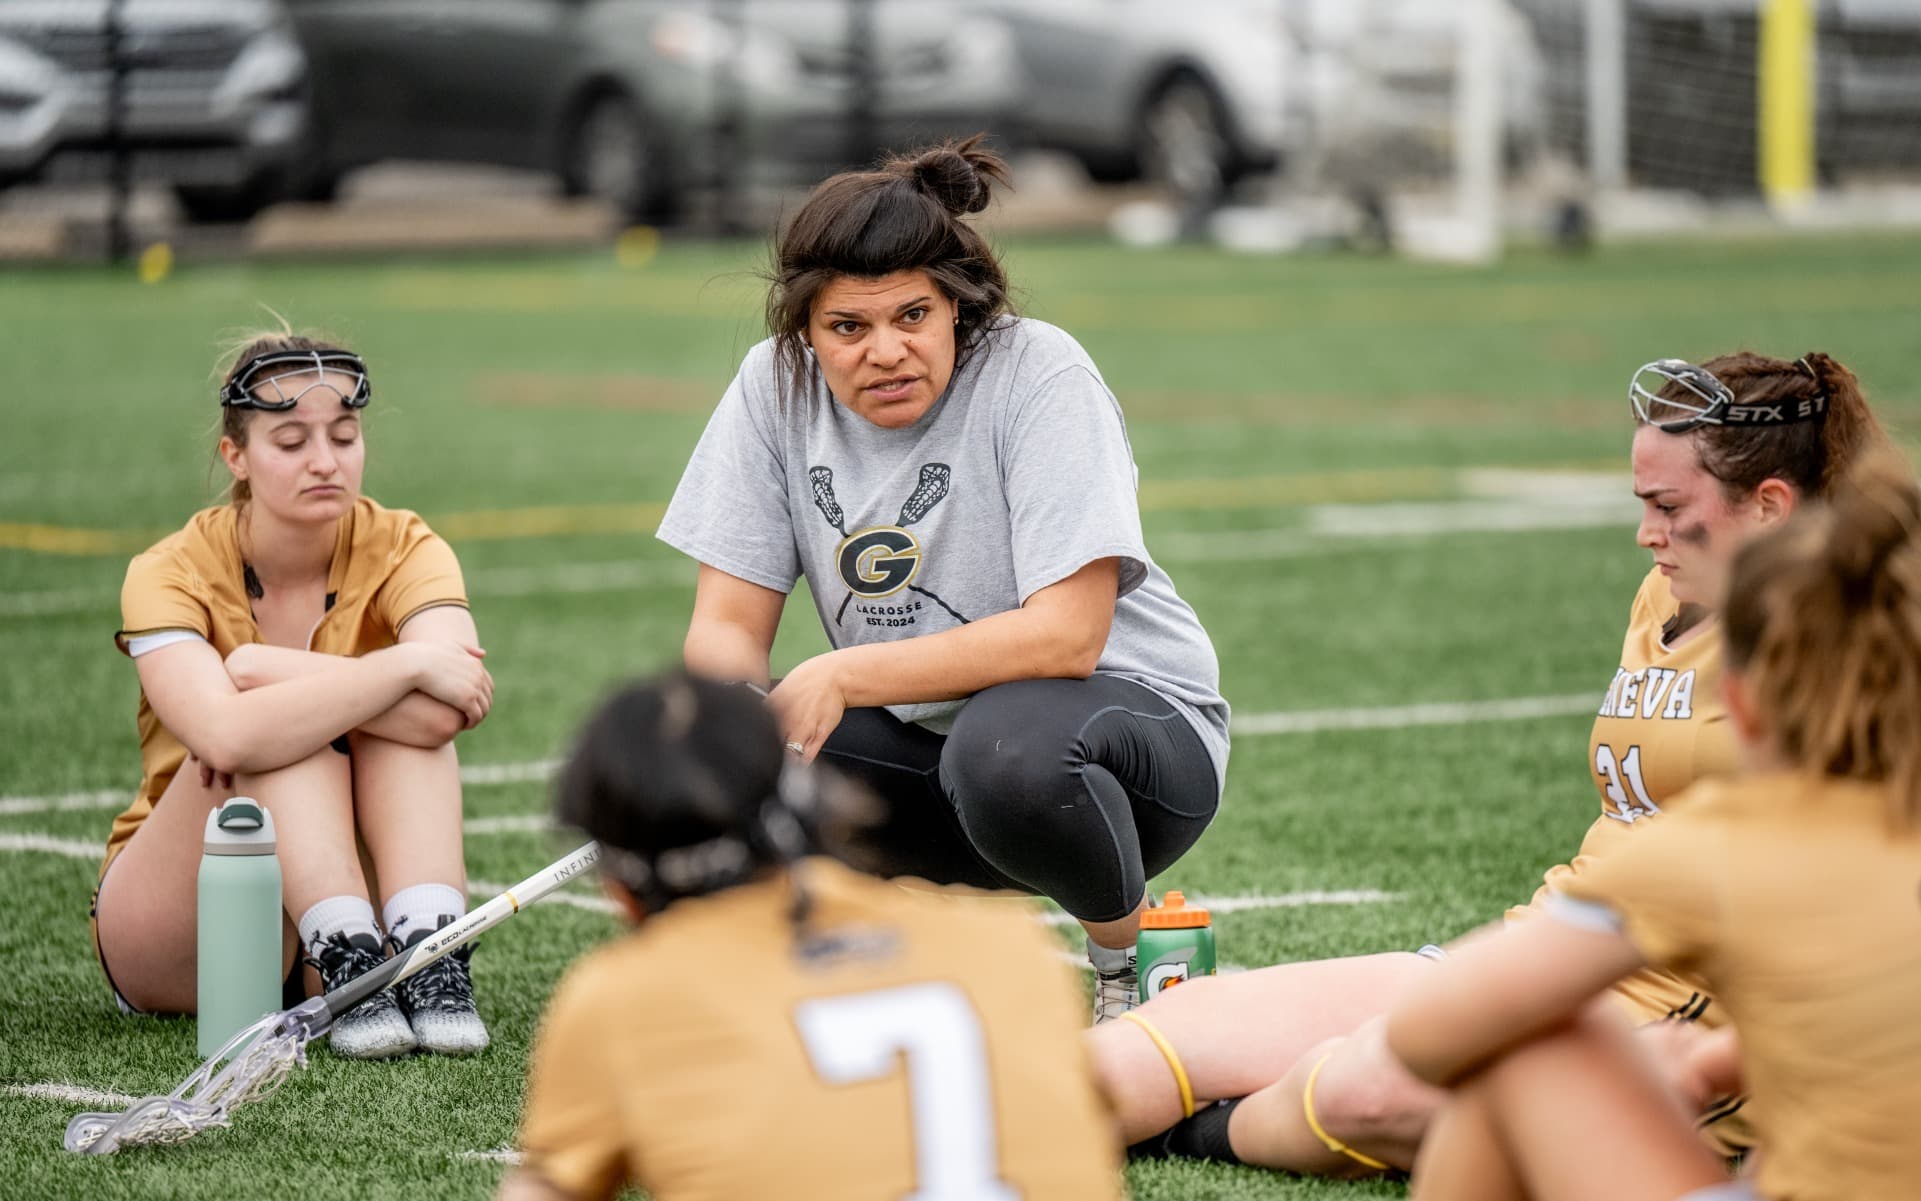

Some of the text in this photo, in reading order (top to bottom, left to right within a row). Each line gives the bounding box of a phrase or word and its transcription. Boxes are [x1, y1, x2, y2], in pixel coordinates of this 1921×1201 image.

[1726, 405, 1784, 422] STX
[836, 525, 922, 599] G
[856, 601, 922, 615] LACROSSE
[866, 616, 916, 627] EST. 2024
[1595, 743, 1661, 824] 31
[793, 981, 1022, 1201] 7
